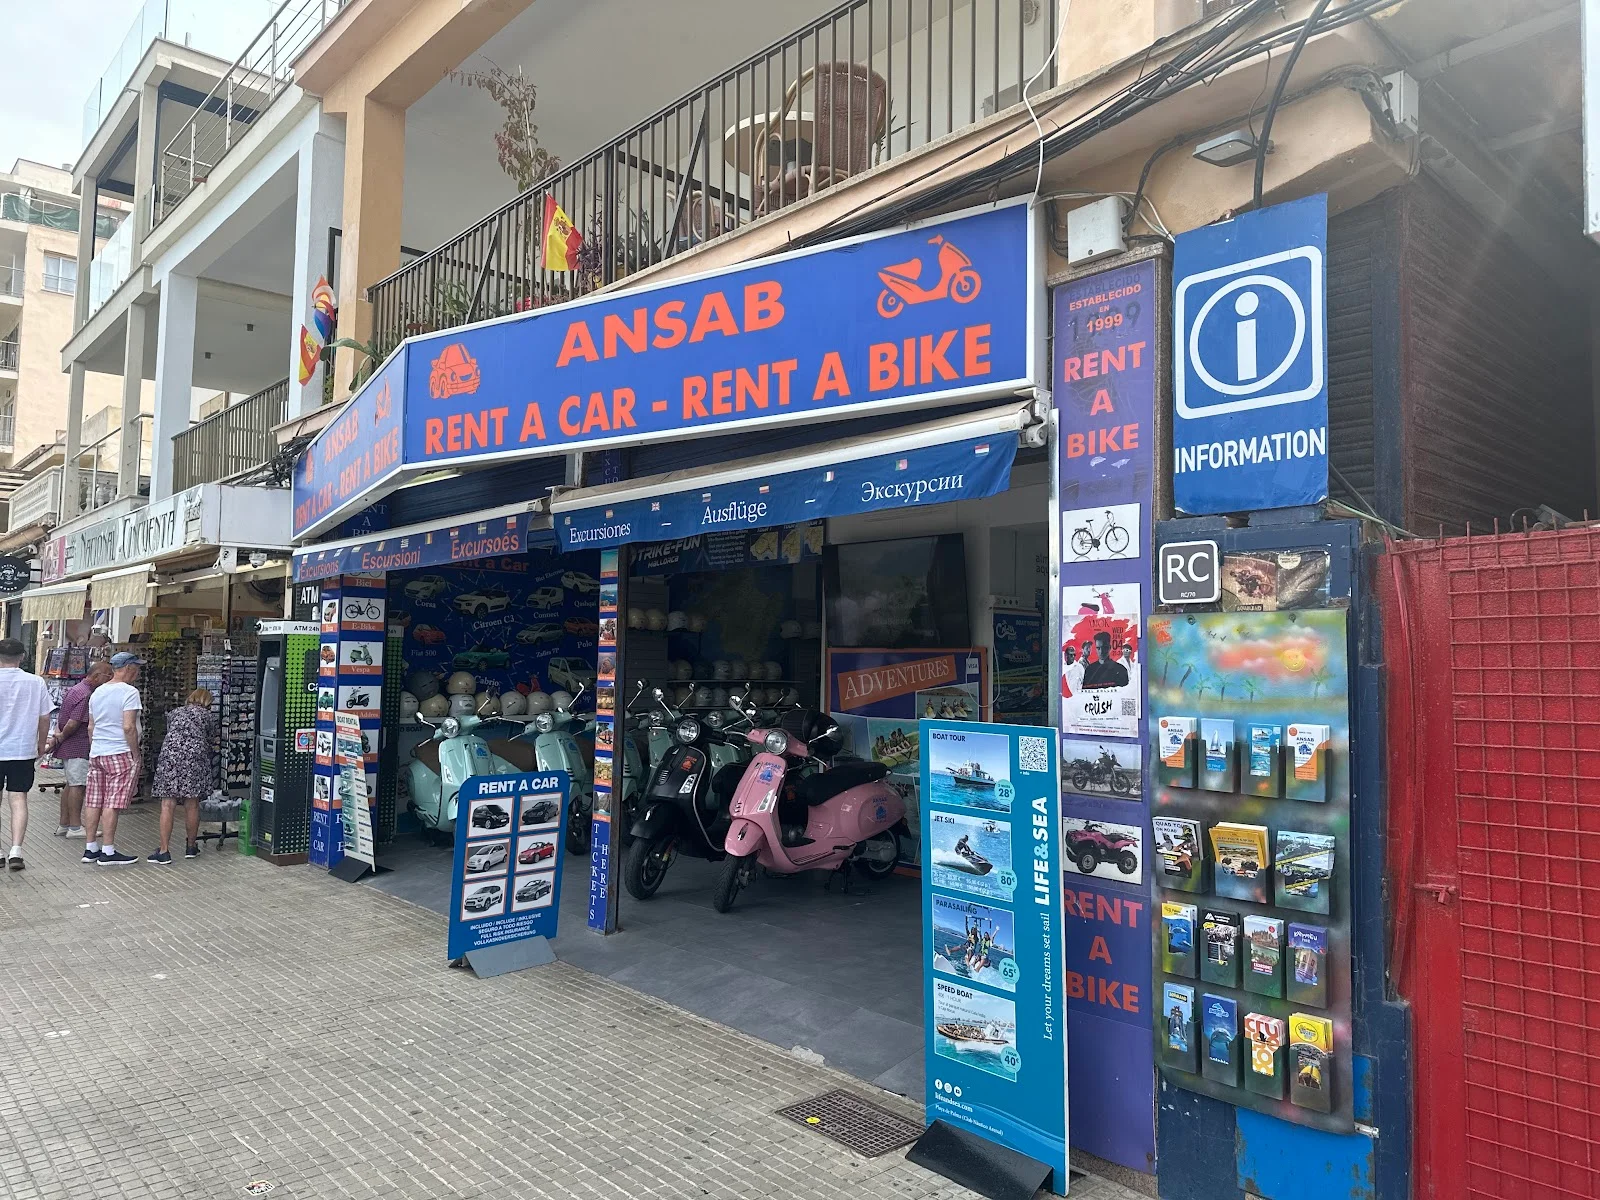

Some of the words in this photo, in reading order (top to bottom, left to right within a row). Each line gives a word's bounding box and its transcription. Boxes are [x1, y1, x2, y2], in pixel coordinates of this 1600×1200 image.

[1069, 283, 1142, 311] ESTABLECIDO
[1099, 305, 1110, 313] EN
[556, 281, 785, 368] ANSAB
[1087, 313, 1123, 333] 1999
[1064, 341, 1146, 383] RENT
[425, 407, 508, 455] RENT
[519, 402, 546, 442] A
[558, 387, 636, 437] CAR
[682, 358, 797, 421] RENT
[813, 351, 851, 400] A
[869, 323, 991, 393] BIKE
[1090, 389, 1114, 416] A
[325, 410, 358, 465] ANSAB
[1067, 423, 1140, 459] BIKE
[1175, 427, 1326, 473] INFORMATION
[318, 481, 333, 514] CAR
[340, 457, 361, 499] RENT
[364, 451, 371, 483] A
[374, 425, 399, 475] BIKE
[861, 474, 963, 502] Экскурсии
[569, 520, 631, 544] Excursiones
[702, 500, 768, 525] Ausflüge
[300, 560, 339, 580] Excursions
[362, 546, 421, 570] Escursioni
[452, 533, 519, 560] Excursoés
[637, 537, 701, 562] TRIKE-FUN
[501, 558, 530, 572] Car
[1167, 552, 1210, 583] RC
[301, 586, 319, 605] ATM
[415, 599, 437, 609] Corsa
[574, 600, 597, 609] Qashqai
[473, 618, 502, 631] Citroen
[504, 615, 515, 625] C3
[533, 611, 560, 619] Connect
[577, 640, 593, 649] Polo
[1112, 640, 1123, 650] 04
[474, 675, 500, 687] Cabrio
[845, 658, 949, 701] ADVENTURES
[1084, 700, 1112, 715] CRUSH
[933, 733, 949, 741] BOAT
[950, 734, 966, 742] TOUR
[479, 780, 516, 795] RENT
[518, 779, 528, 791] A
[531, 777, 559, 790] CAR
[313, 811, 328, 825] RENT
[934, 815, 943, 823] JET
[944, 816, 955, 824] SKI
[317, 827, 322, 837] A
[313, 840, 324, 852] CAR
[1032, 797, 1049, 905] LIFE&SEA
[589, 823, 600, 920] TICKETS
[600, 844, 609, 900] HERE
[936, 899, 978, 915] PARASAILING
[1065, 889, 1142, 928] RENT
[470, 922, 493, 931] INCLUIDO
[478, 926, 499, 934] SEGURO
[503, 922, 515, 930] TODO
[504, 925, 531, 935] INSURANCE
[1040, 912, 1050, 932] sail
[1089, 935, 1112, 965] A
[1042, 951, 1051, 992] dreams
[937, 983, 955, 995] SPEED
[956, 987, 973, 1000] BOAT
[1066, 970, 1139, 1013] BIKE
[1044, 994, 1054, 1021] your
[1043, 1022, 1052, 1041] Let
[935, 1091, 973, 1113] lifeandsea.com
